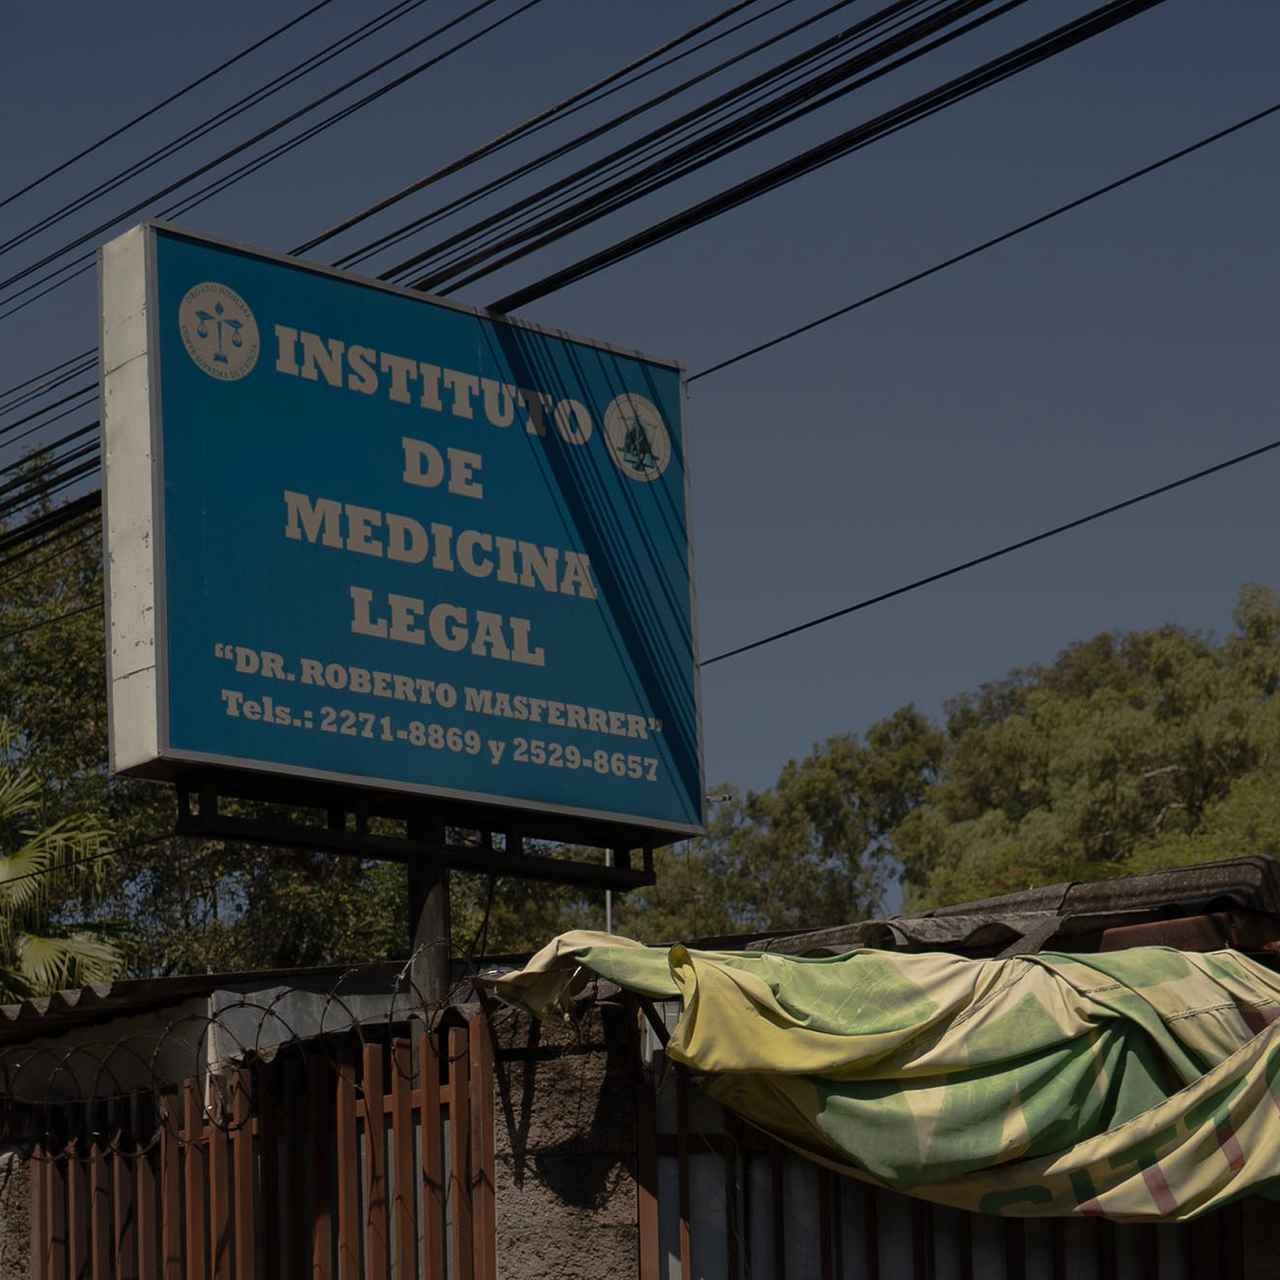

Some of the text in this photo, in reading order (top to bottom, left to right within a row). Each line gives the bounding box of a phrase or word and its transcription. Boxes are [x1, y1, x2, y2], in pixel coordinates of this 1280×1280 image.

[275, 324, 593, 446] INSTITUTO
[402, 437, 484, 500] DE
[284, 490, 598, 600] MEDICINA
[350, 586, 546, 667] LEGAL
[301, 660, 458, 709] ROBERTO
[222, 689, 660, 783] Tels.: 2271-8869 y 2529-8657
